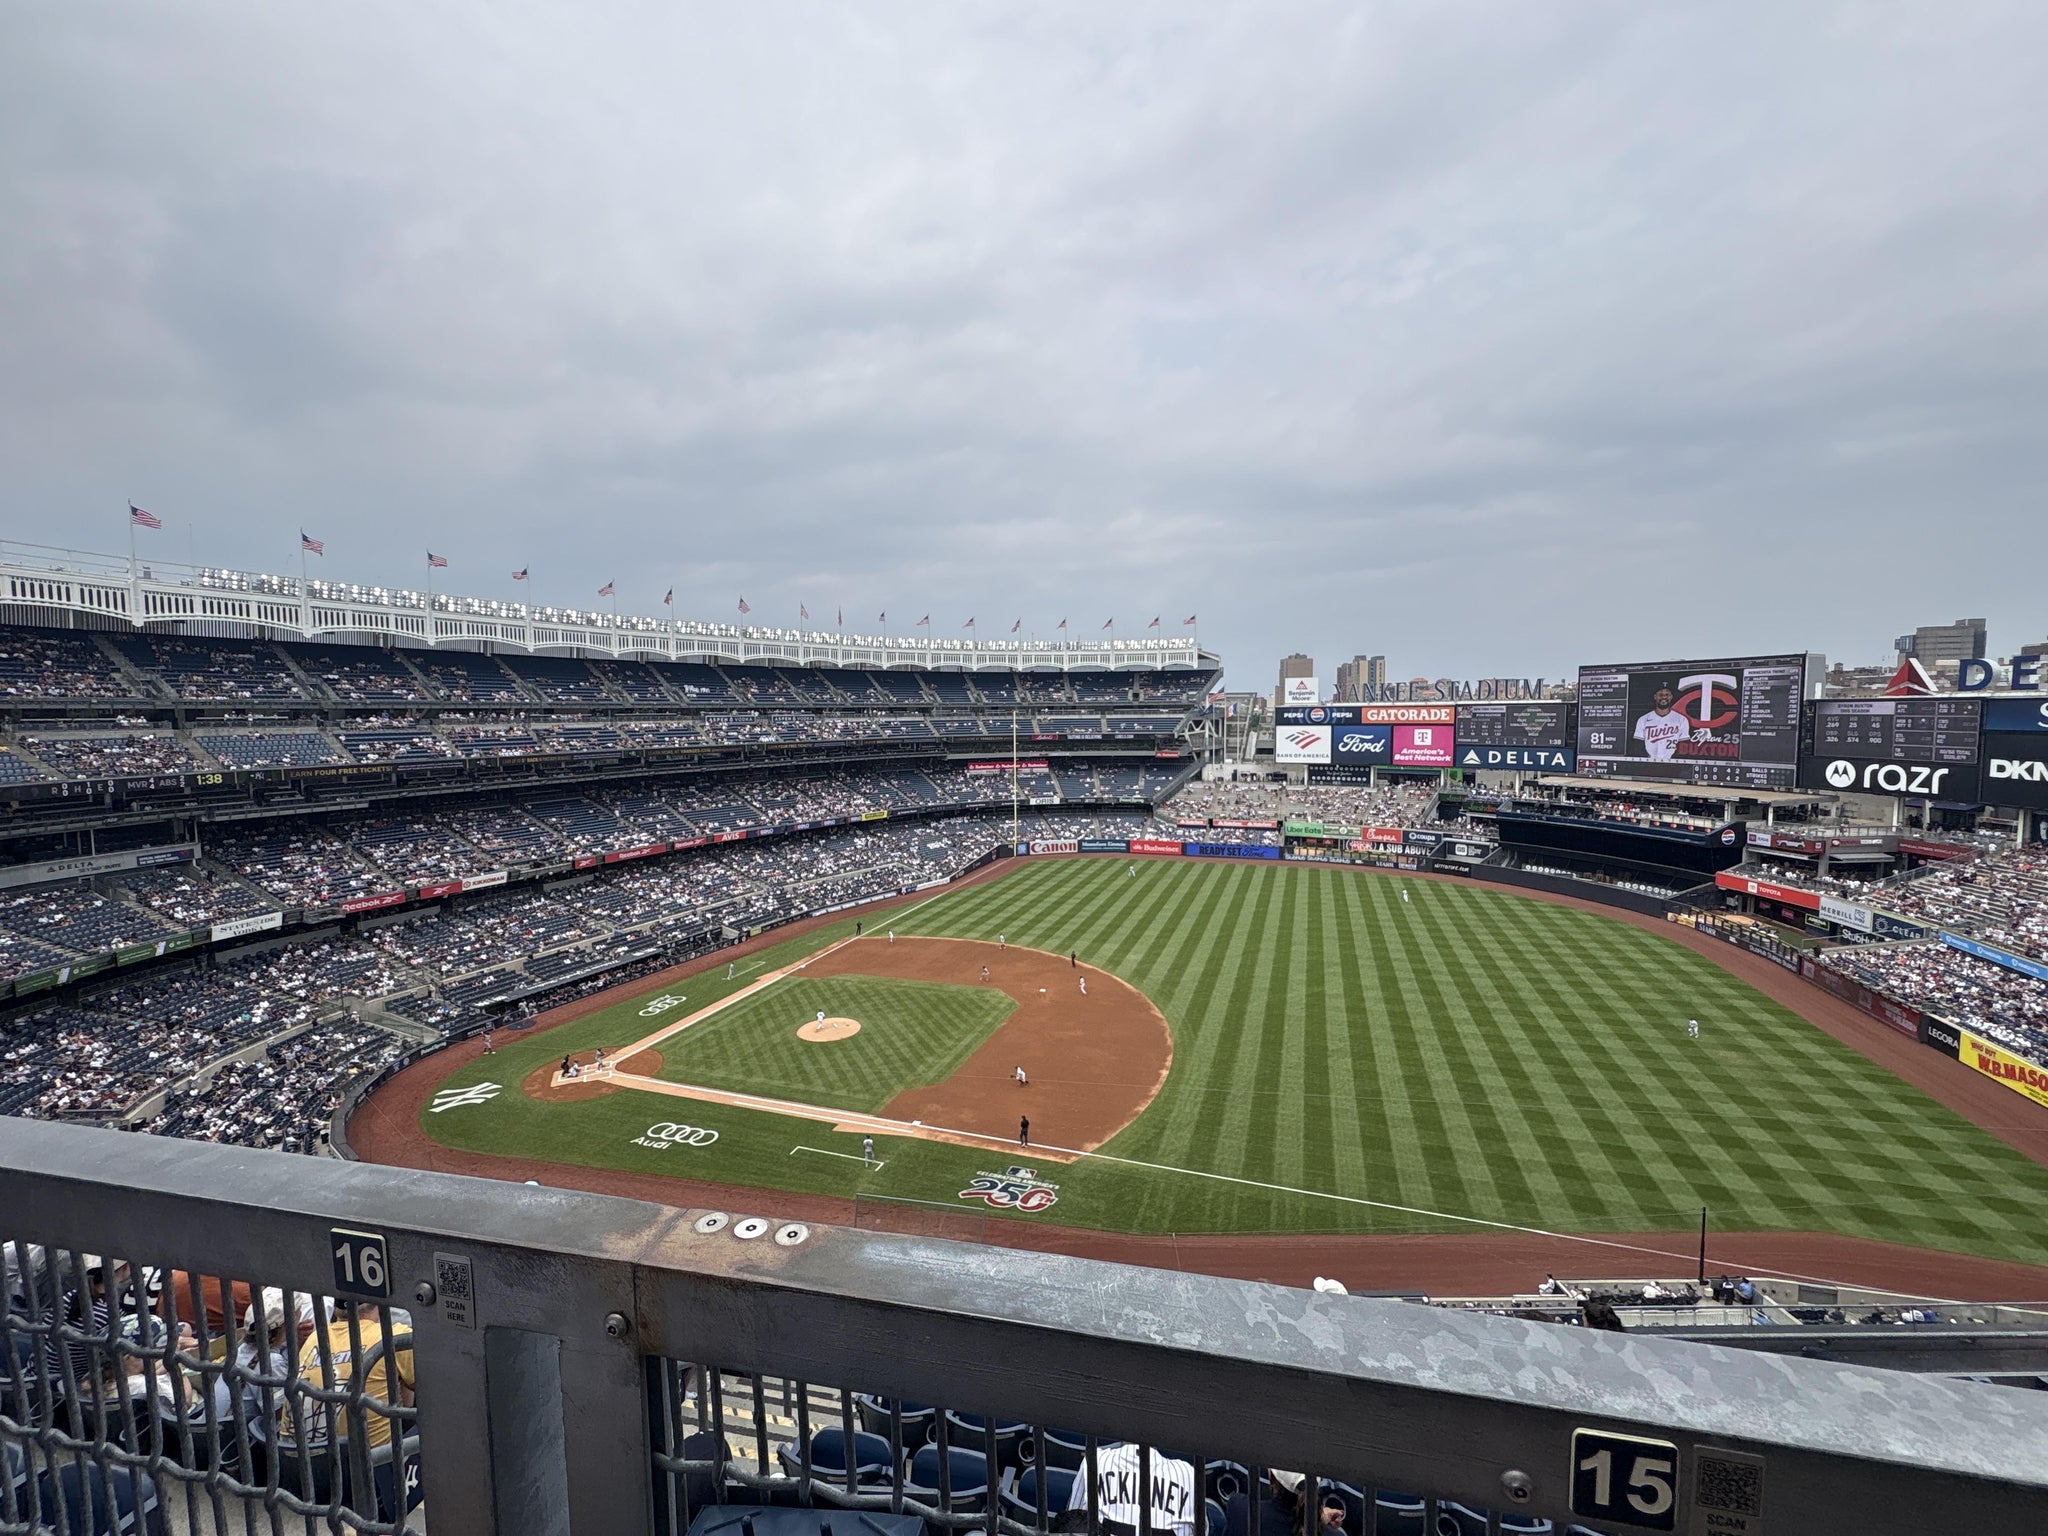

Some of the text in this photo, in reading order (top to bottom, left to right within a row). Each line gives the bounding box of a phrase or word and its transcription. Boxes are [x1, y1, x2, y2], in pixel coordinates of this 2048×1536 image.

[1289, 690, 1315, 698] Benjamin
[1333, 678, 1545, 702] YANKEE STADIUM
[1367, 708, 1450, 721] GATORADE
[1590, 733, 1605, 743] 81
[1645, 724, 1679, 740] Twins
[1690, 728, 1739, 746] Byron 25
[1338, 733, 1386, 752] Ford
[1666, 740, 1678, 749] 25
[1678, 743, 1739, 757] BUXTON
[1414, 754, 1452, 762] Network
[1488, 751, 1566, 766] DELTA
[290, 770, 312, 778] EARN
[315, 769, 337, 777] FOUR
[359, 766, 393, 774] TICKETS!
[128, 781, 148, 789] MVR
[197, 774, 223, 785] 1:38
[1863, 763, 1949, 795] razr
[74, 785, 81, 793] H
[721, 833, 740, 841] AVIS
[675, 840, 694, 848] Reebok
[1031, 842, 1076, 853] Canon
[1144, 844, 1179, 852] Budweiser
[1379, 844, 1384, 852] A
[1386, 845, 1403, 854] SUB
[1404, 846, 1432, 856] ABOVE
[618, 850, 643, 859] Reebok
[1199, 846, 1265, 857] READY SET Ford
[58, 861, 94, 871] DELTA
[472, 876, 505, 886] KIKKOMAN
[1758, 886, 1782, 896] TOYOTA
[342, 899, 380, 912] Reebok
[1821, 906, 1852, 920] MERRILL
[220, 915, 276, 934] STATESIDE
[1699, 924, 1717, 936] STARR
[233, 926, 264, 936] VODKA
[1971, 1042, 1996, 1057] WHO BUT
[630, 1136, 673, 1150] Audi
[976, 1170, 1060, 1190] CELEBRATING AMERICA'S
[336, 1242, 384, 1287] 16
[445, 1301, 466, 1311] SCAN
[447, 1312, 465, 1323] HERE
[1580, 1449, 1673, 1515] 15
[1097, 1471, 1189, 1520] MCKINEY
[1707, 1514, 1747, 1531] SCAN
